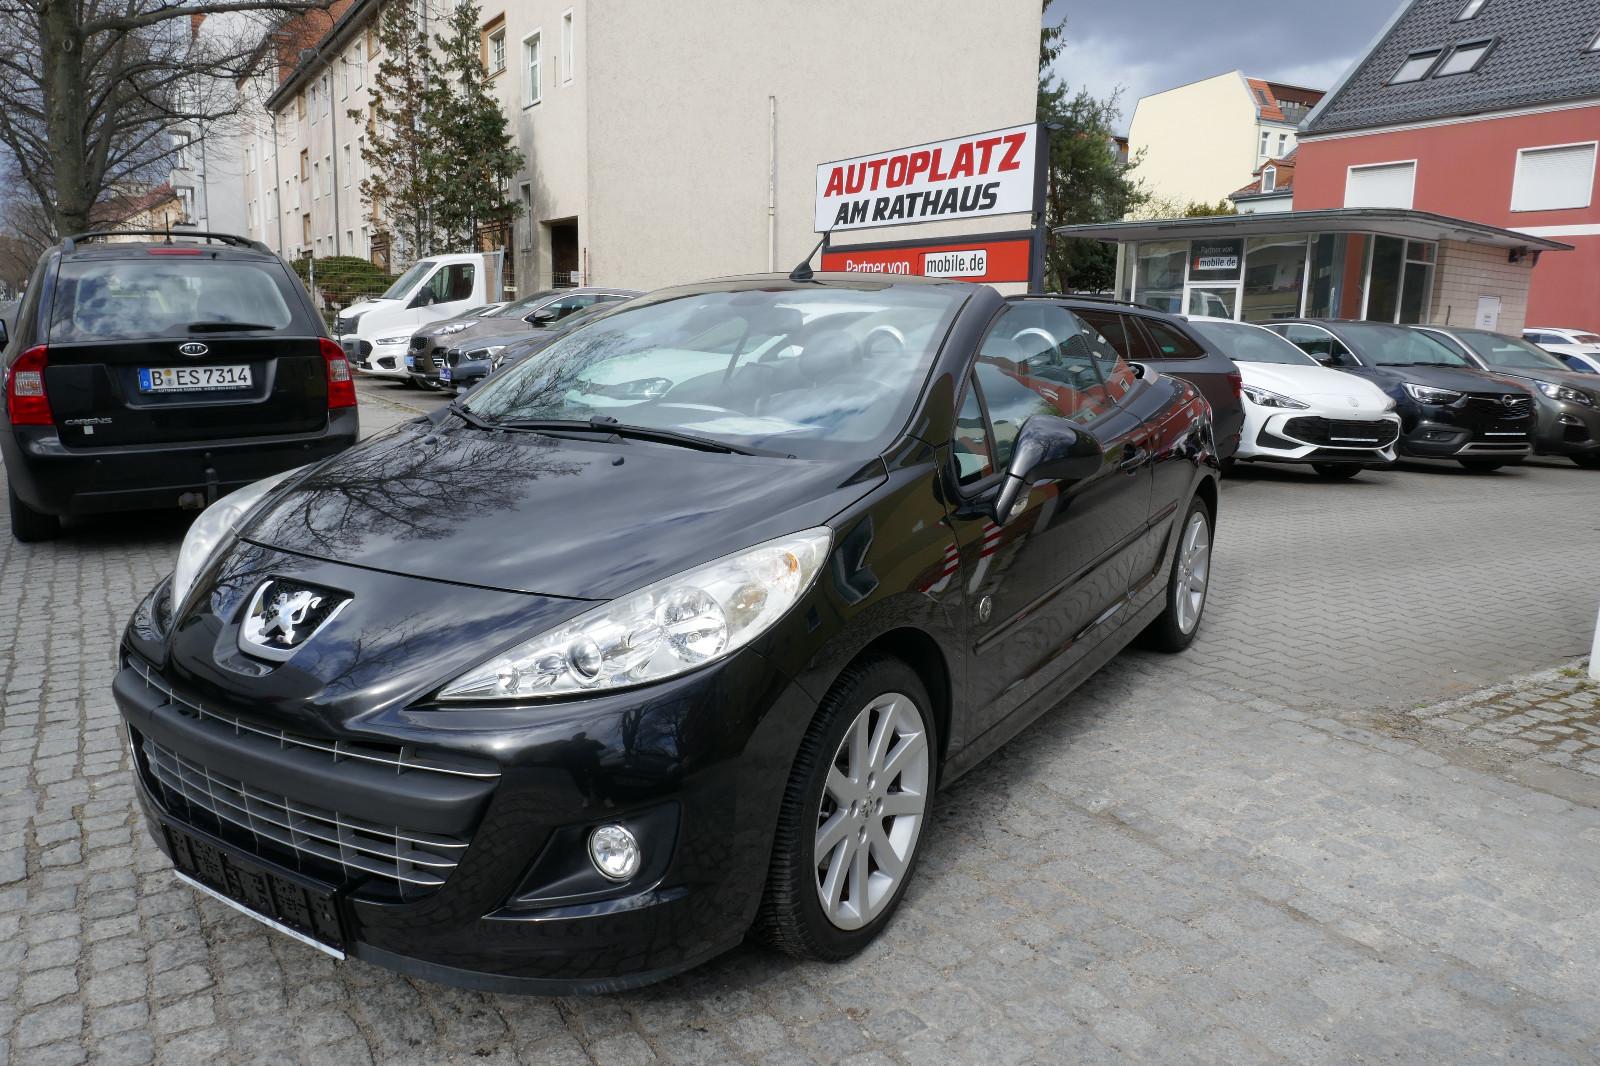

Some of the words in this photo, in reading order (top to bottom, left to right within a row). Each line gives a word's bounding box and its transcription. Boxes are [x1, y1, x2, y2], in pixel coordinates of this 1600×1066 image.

[824, 132, 1027, 197] AUTOPLATZ
[834, 199, 870, 226] AM
[872, 181, 1000, 222] RATHAUS
[846, 259, 886, 273] Partner
[887, 260, 910, 274] von
[926, 254, 984, 273] mobile.de
[1200, 257, 1236, 267] mobile.de
[184, 345, 204, 353] KIA
[151, 370, 164, 386] B
[176, 369, 201, 386] ES
[203, 367, 248, 384] 7314
[64, 417, 113, 425] CARENS
